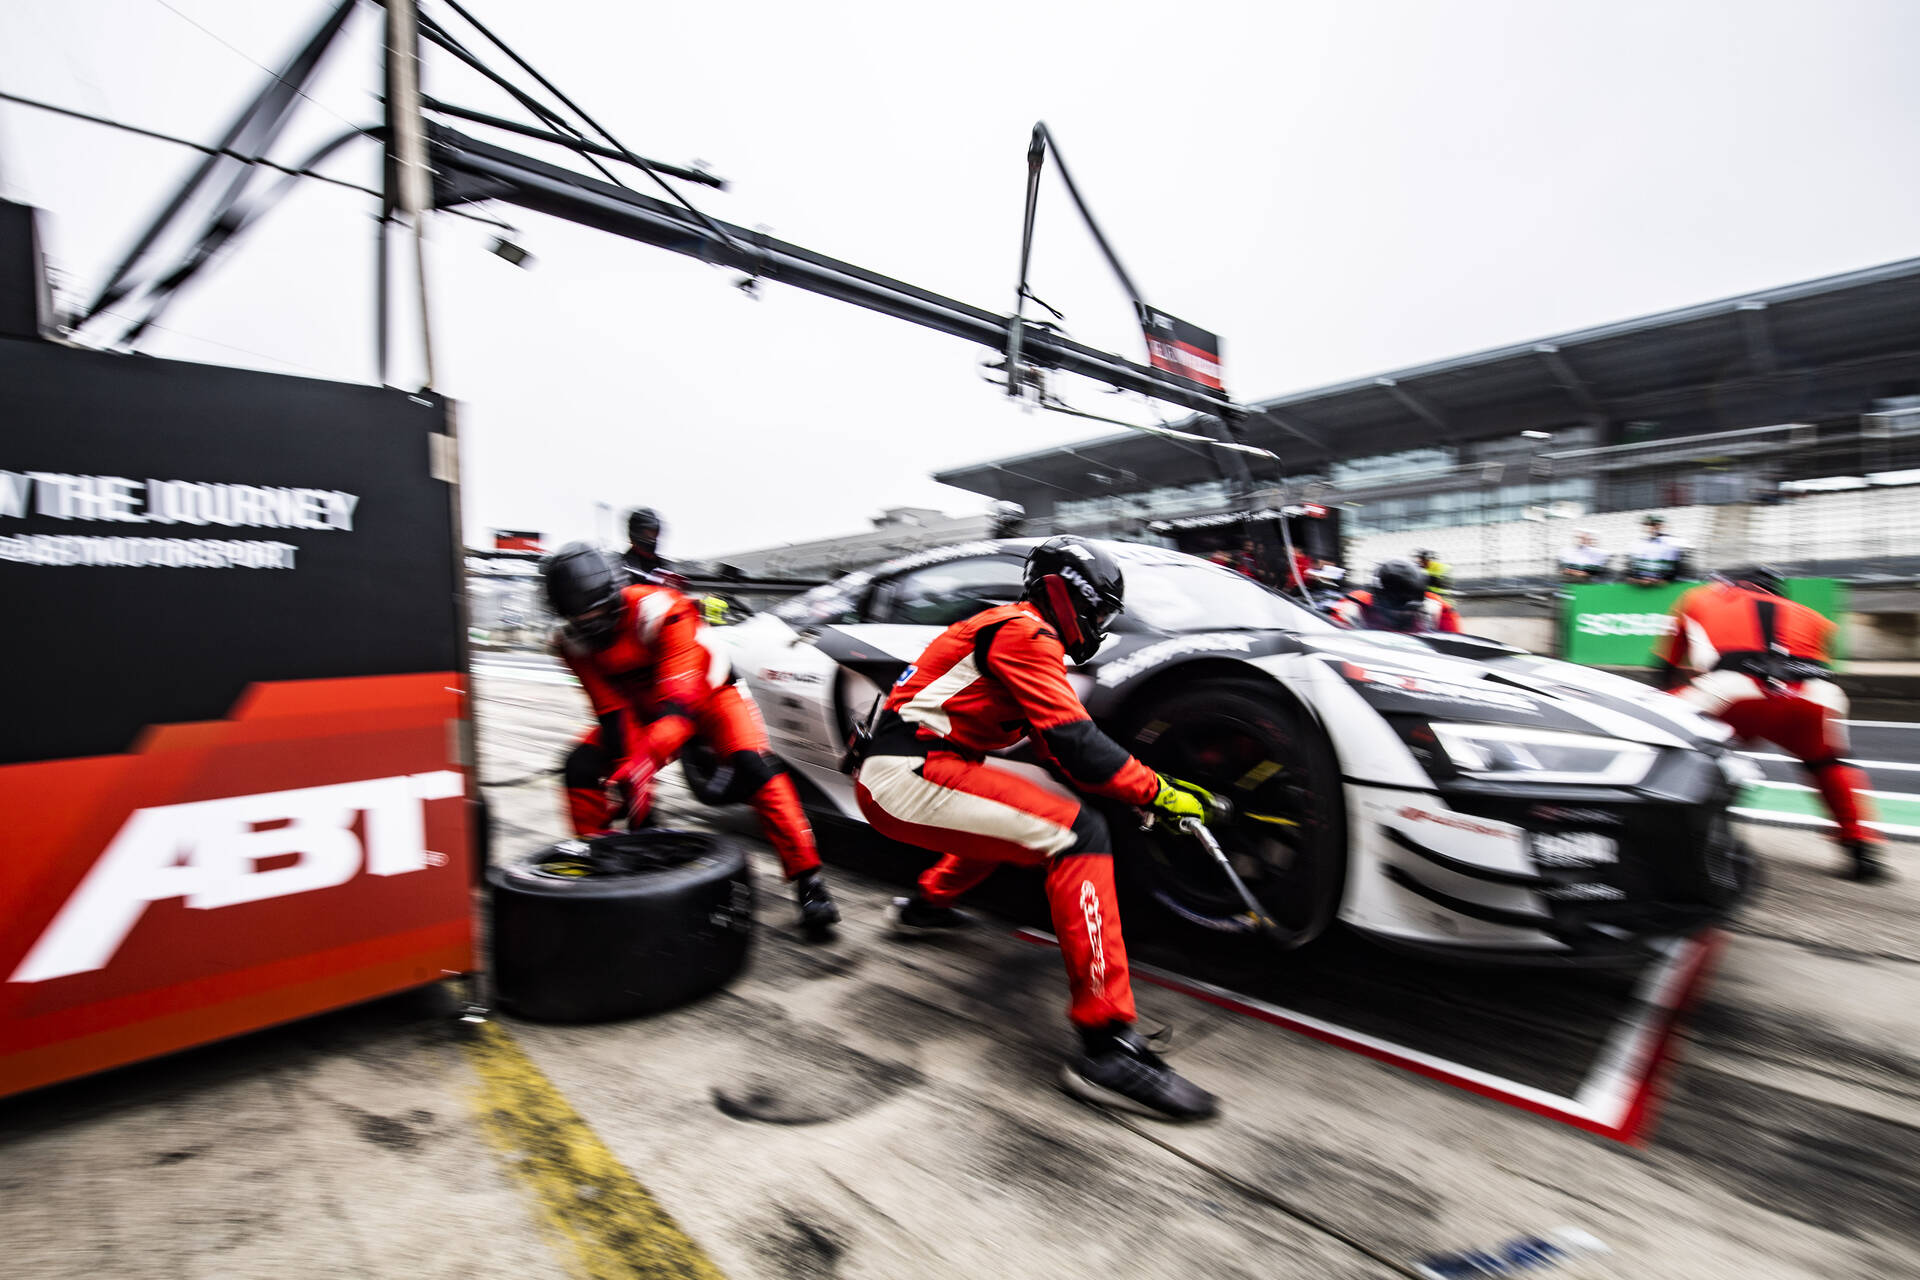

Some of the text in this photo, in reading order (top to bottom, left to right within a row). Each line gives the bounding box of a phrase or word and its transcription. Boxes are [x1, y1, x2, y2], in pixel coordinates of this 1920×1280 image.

[24, 471, 147, 523] THE
[146, 477, 361, 531] JOURNEY
[1060, 566, 1103, 606] uvex
[8, 770, 465, 982] ABT
